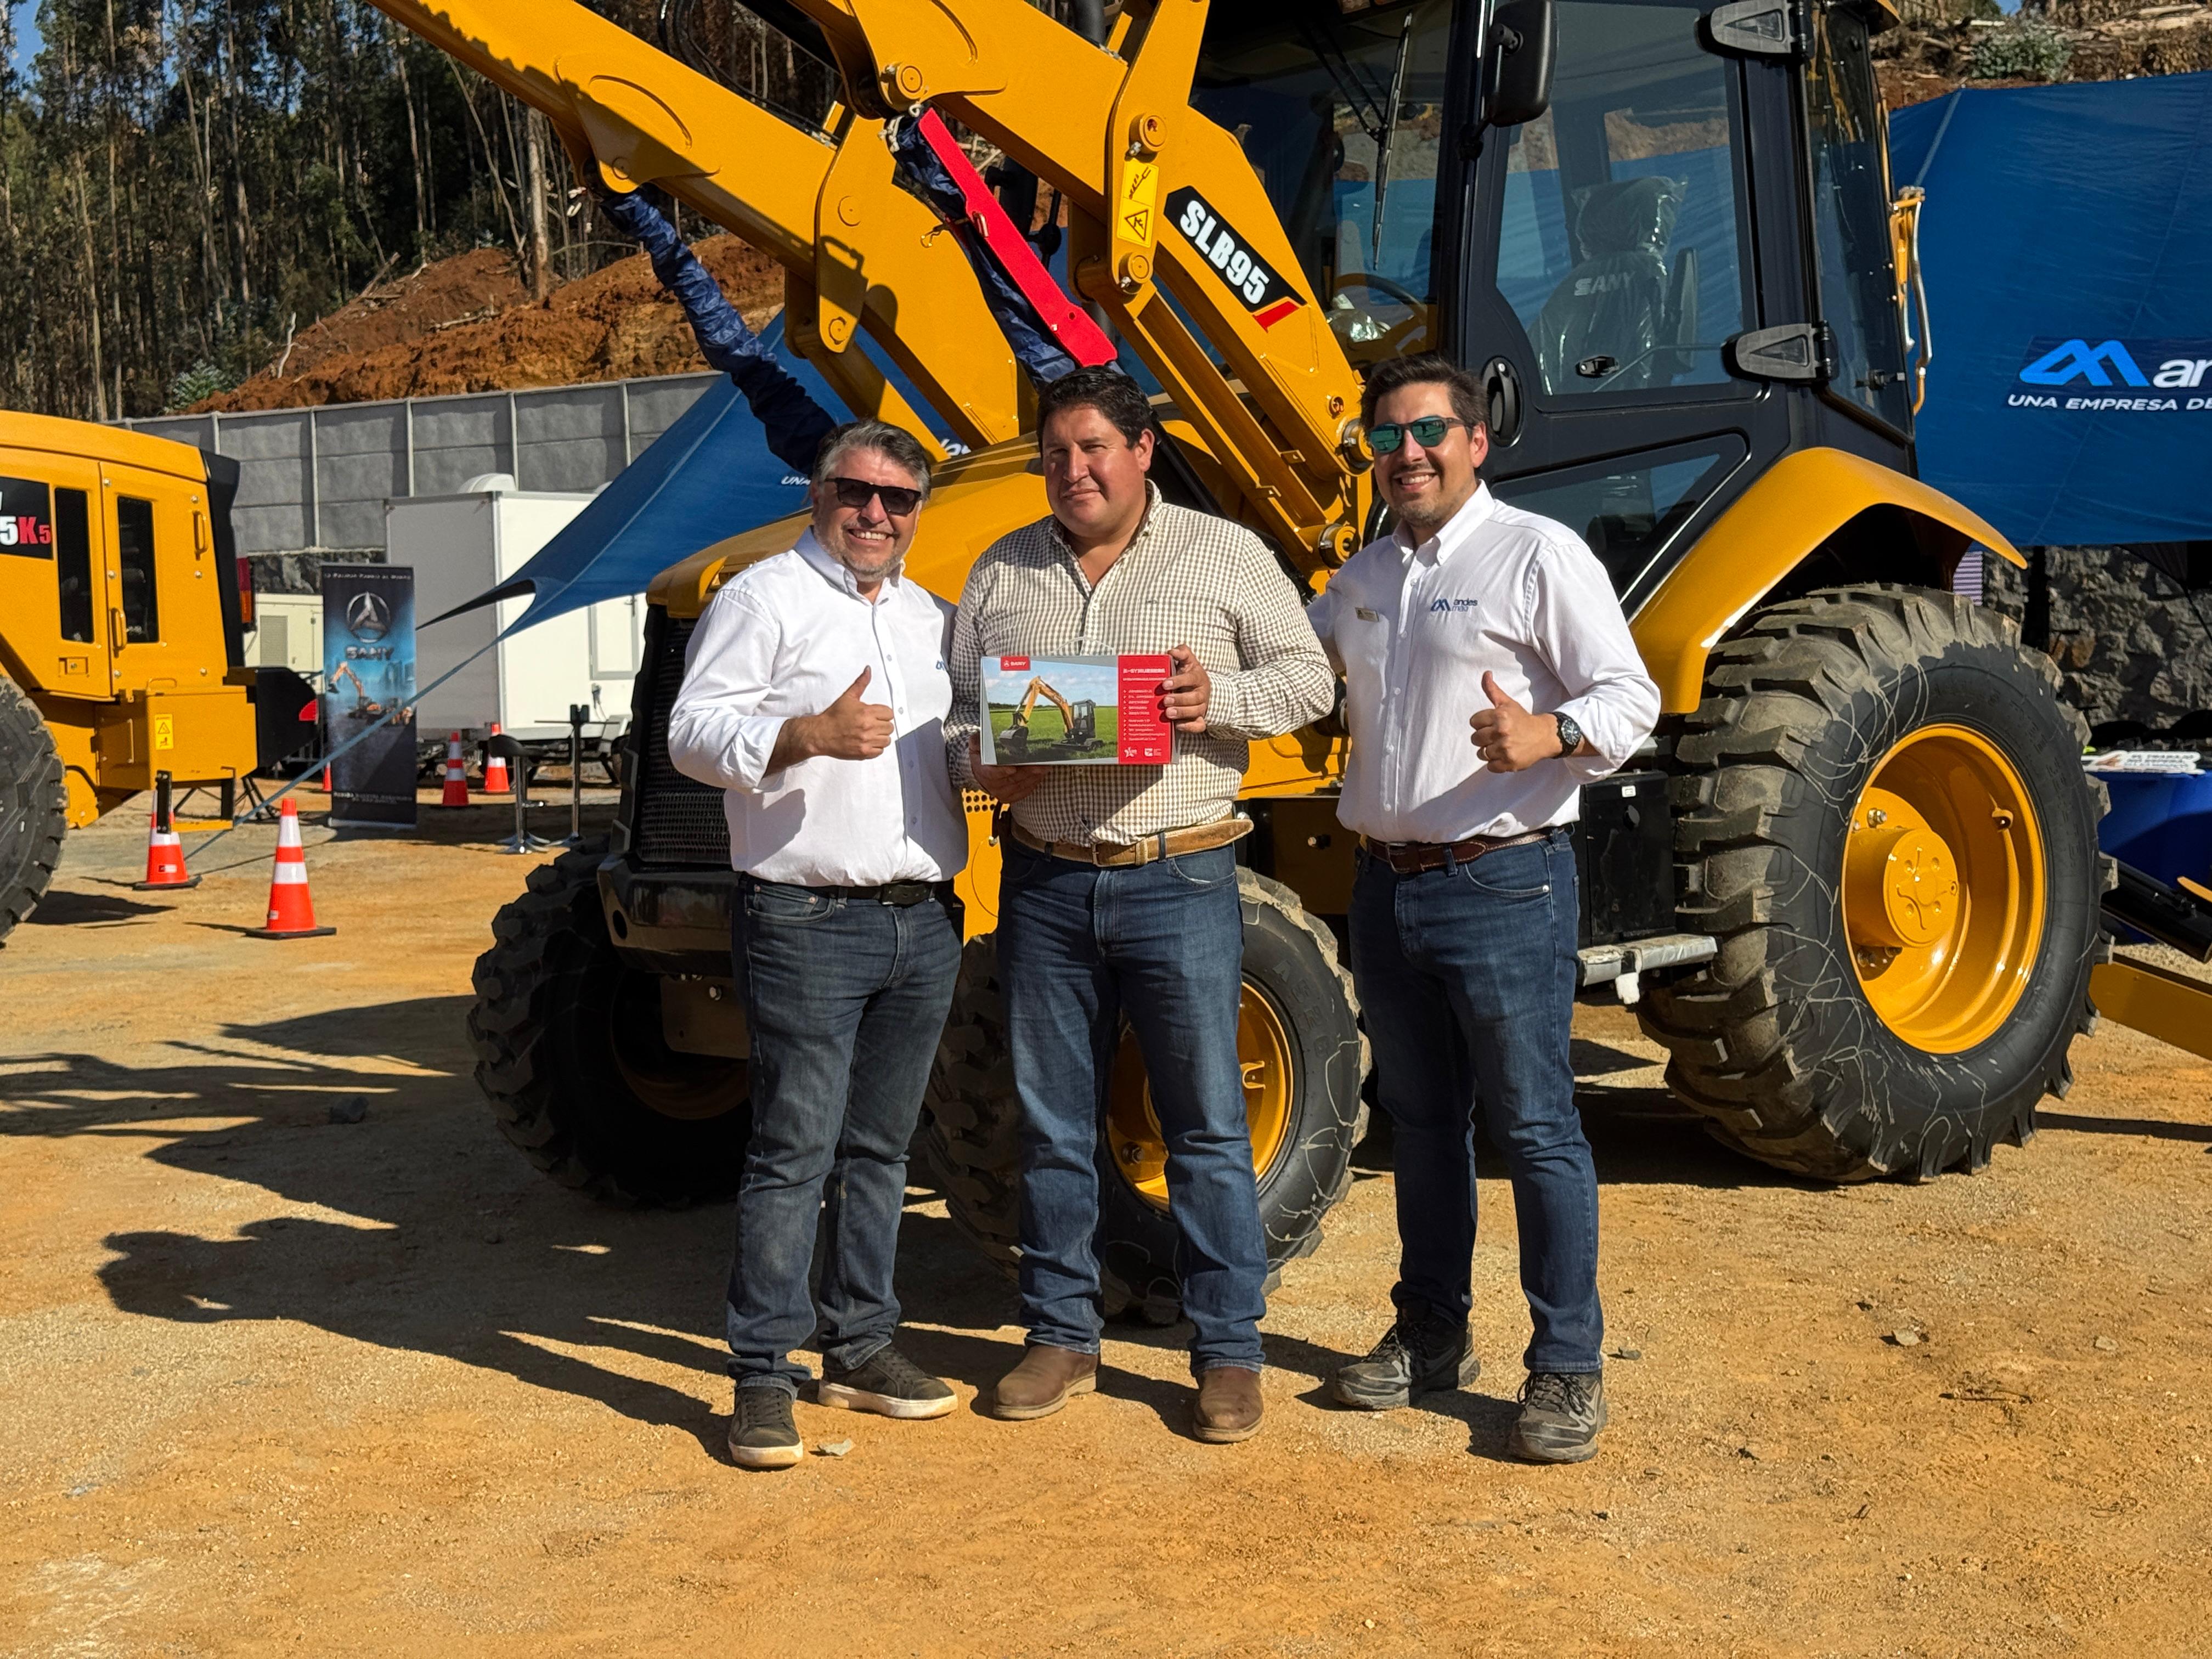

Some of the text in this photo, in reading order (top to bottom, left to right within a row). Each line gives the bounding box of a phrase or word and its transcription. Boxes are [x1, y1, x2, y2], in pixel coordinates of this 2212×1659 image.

[1180, 200, 1270, 304] SLB95
[1574, 272, 1635, 296] SANY
[2008, 393, 2057, 408] UNA
[2065, 397, 2178, 411] EMPRESA
[1453, 597, 1478, 606] andes
